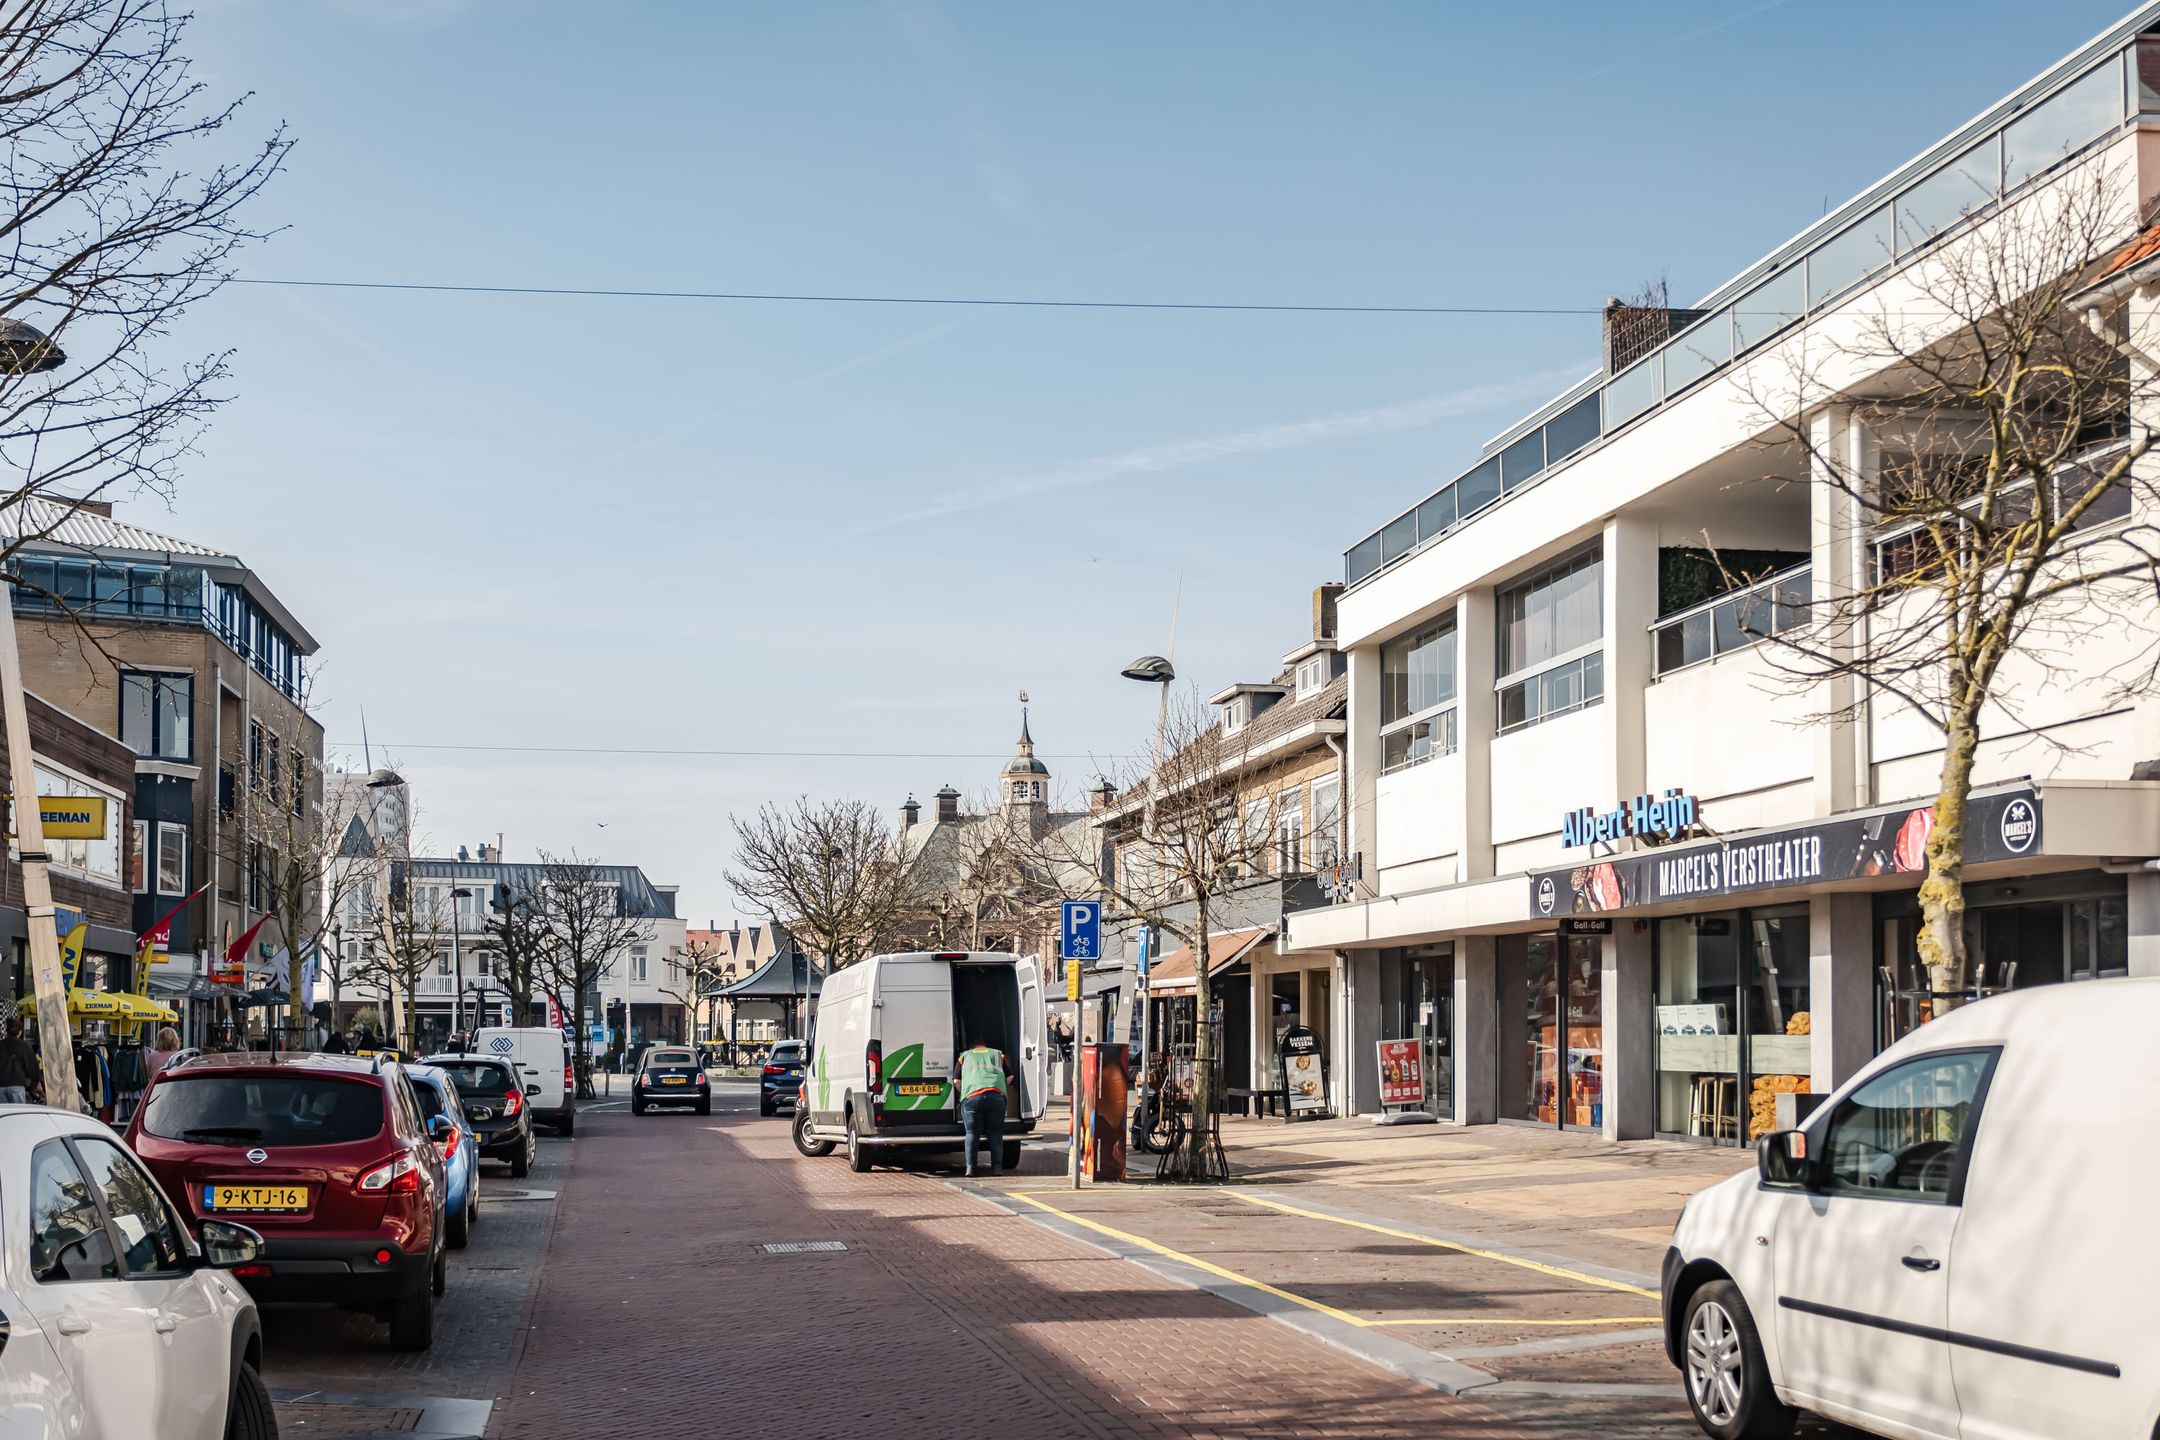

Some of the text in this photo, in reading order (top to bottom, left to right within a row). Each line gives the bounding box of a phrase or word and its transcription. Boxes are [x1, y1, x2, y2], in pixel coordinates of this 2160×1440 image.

[40, 811, 90, 823] EEMAN
[1562, 788, 1696, 849] Albert Heijn
[1659, 835, 1821, 897] MARCEL'S VERSTHEATER
[1071, 905, 1092, 935] P
[84, 1002, 113, 1010] ZEEMAN
[132, 1011, 159, 1019] ZEEMAN
[222, 1189, 297, 1205] 9-KTJ-16
